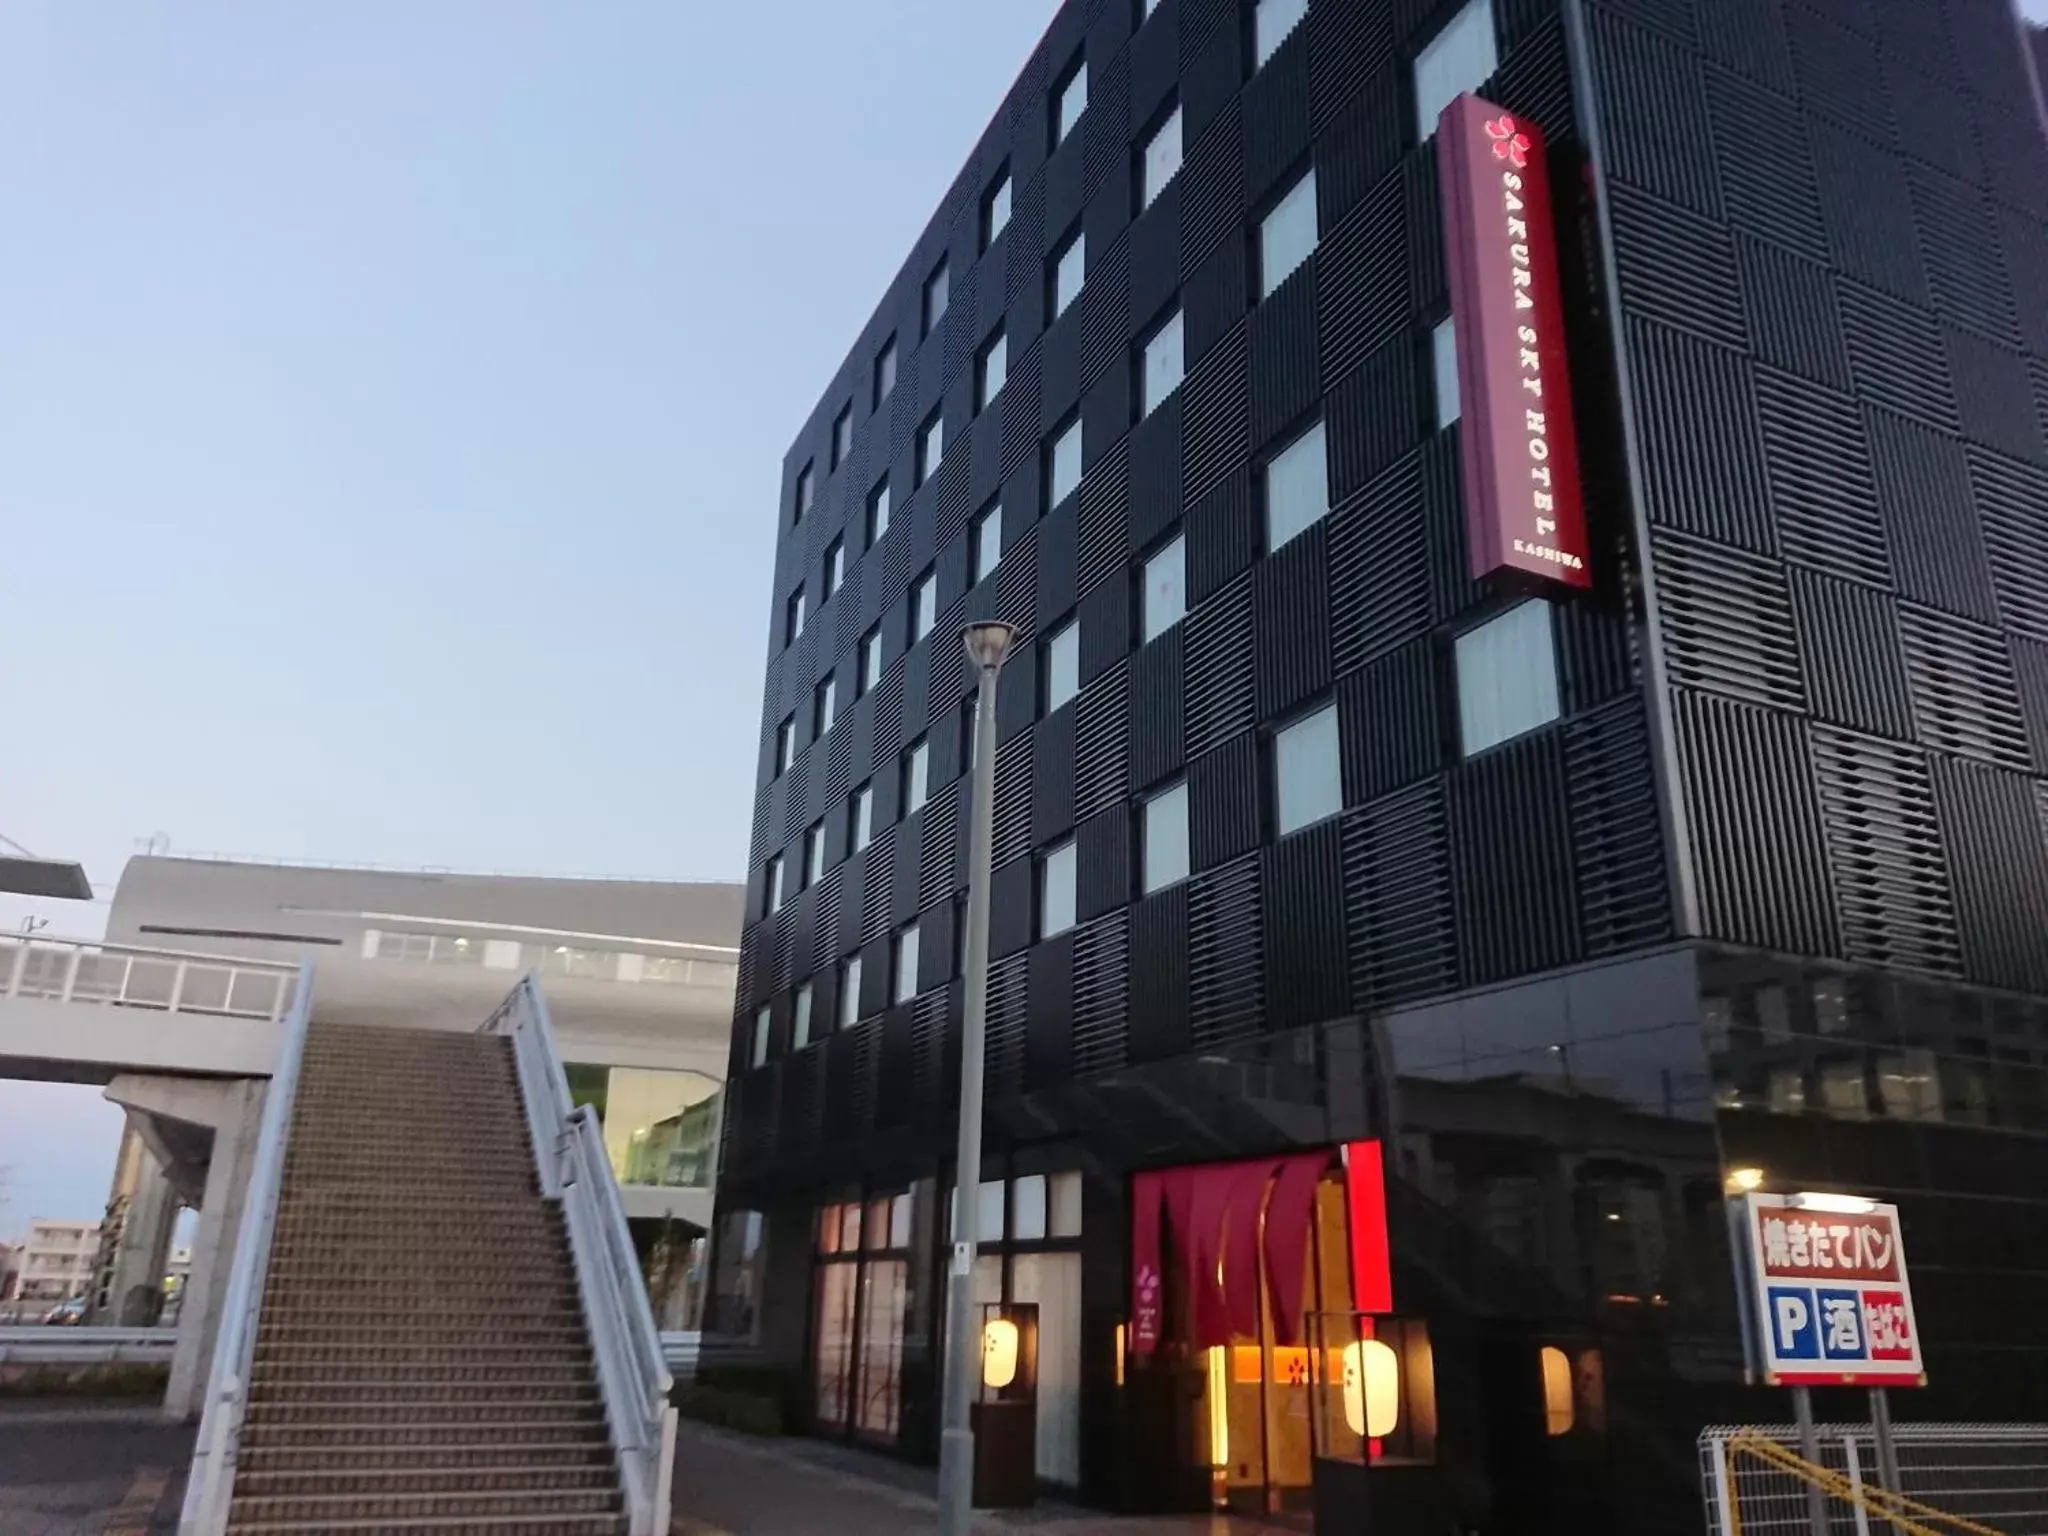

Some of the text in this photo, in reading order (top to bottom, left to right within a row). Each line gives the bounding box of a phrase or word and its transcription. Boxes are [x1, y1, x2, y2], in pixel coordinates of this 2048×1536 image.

[1502, 170, 1556, 536] SAKURA SKY HOTEL
[1513, 538, 1583, 570] KASHIWA
[1763, 1216, 1893, 1270] 焼きたてパン
[1776, 1296, 1808, 1350] P
[1823, 1297, 1861, 1350] 酒
